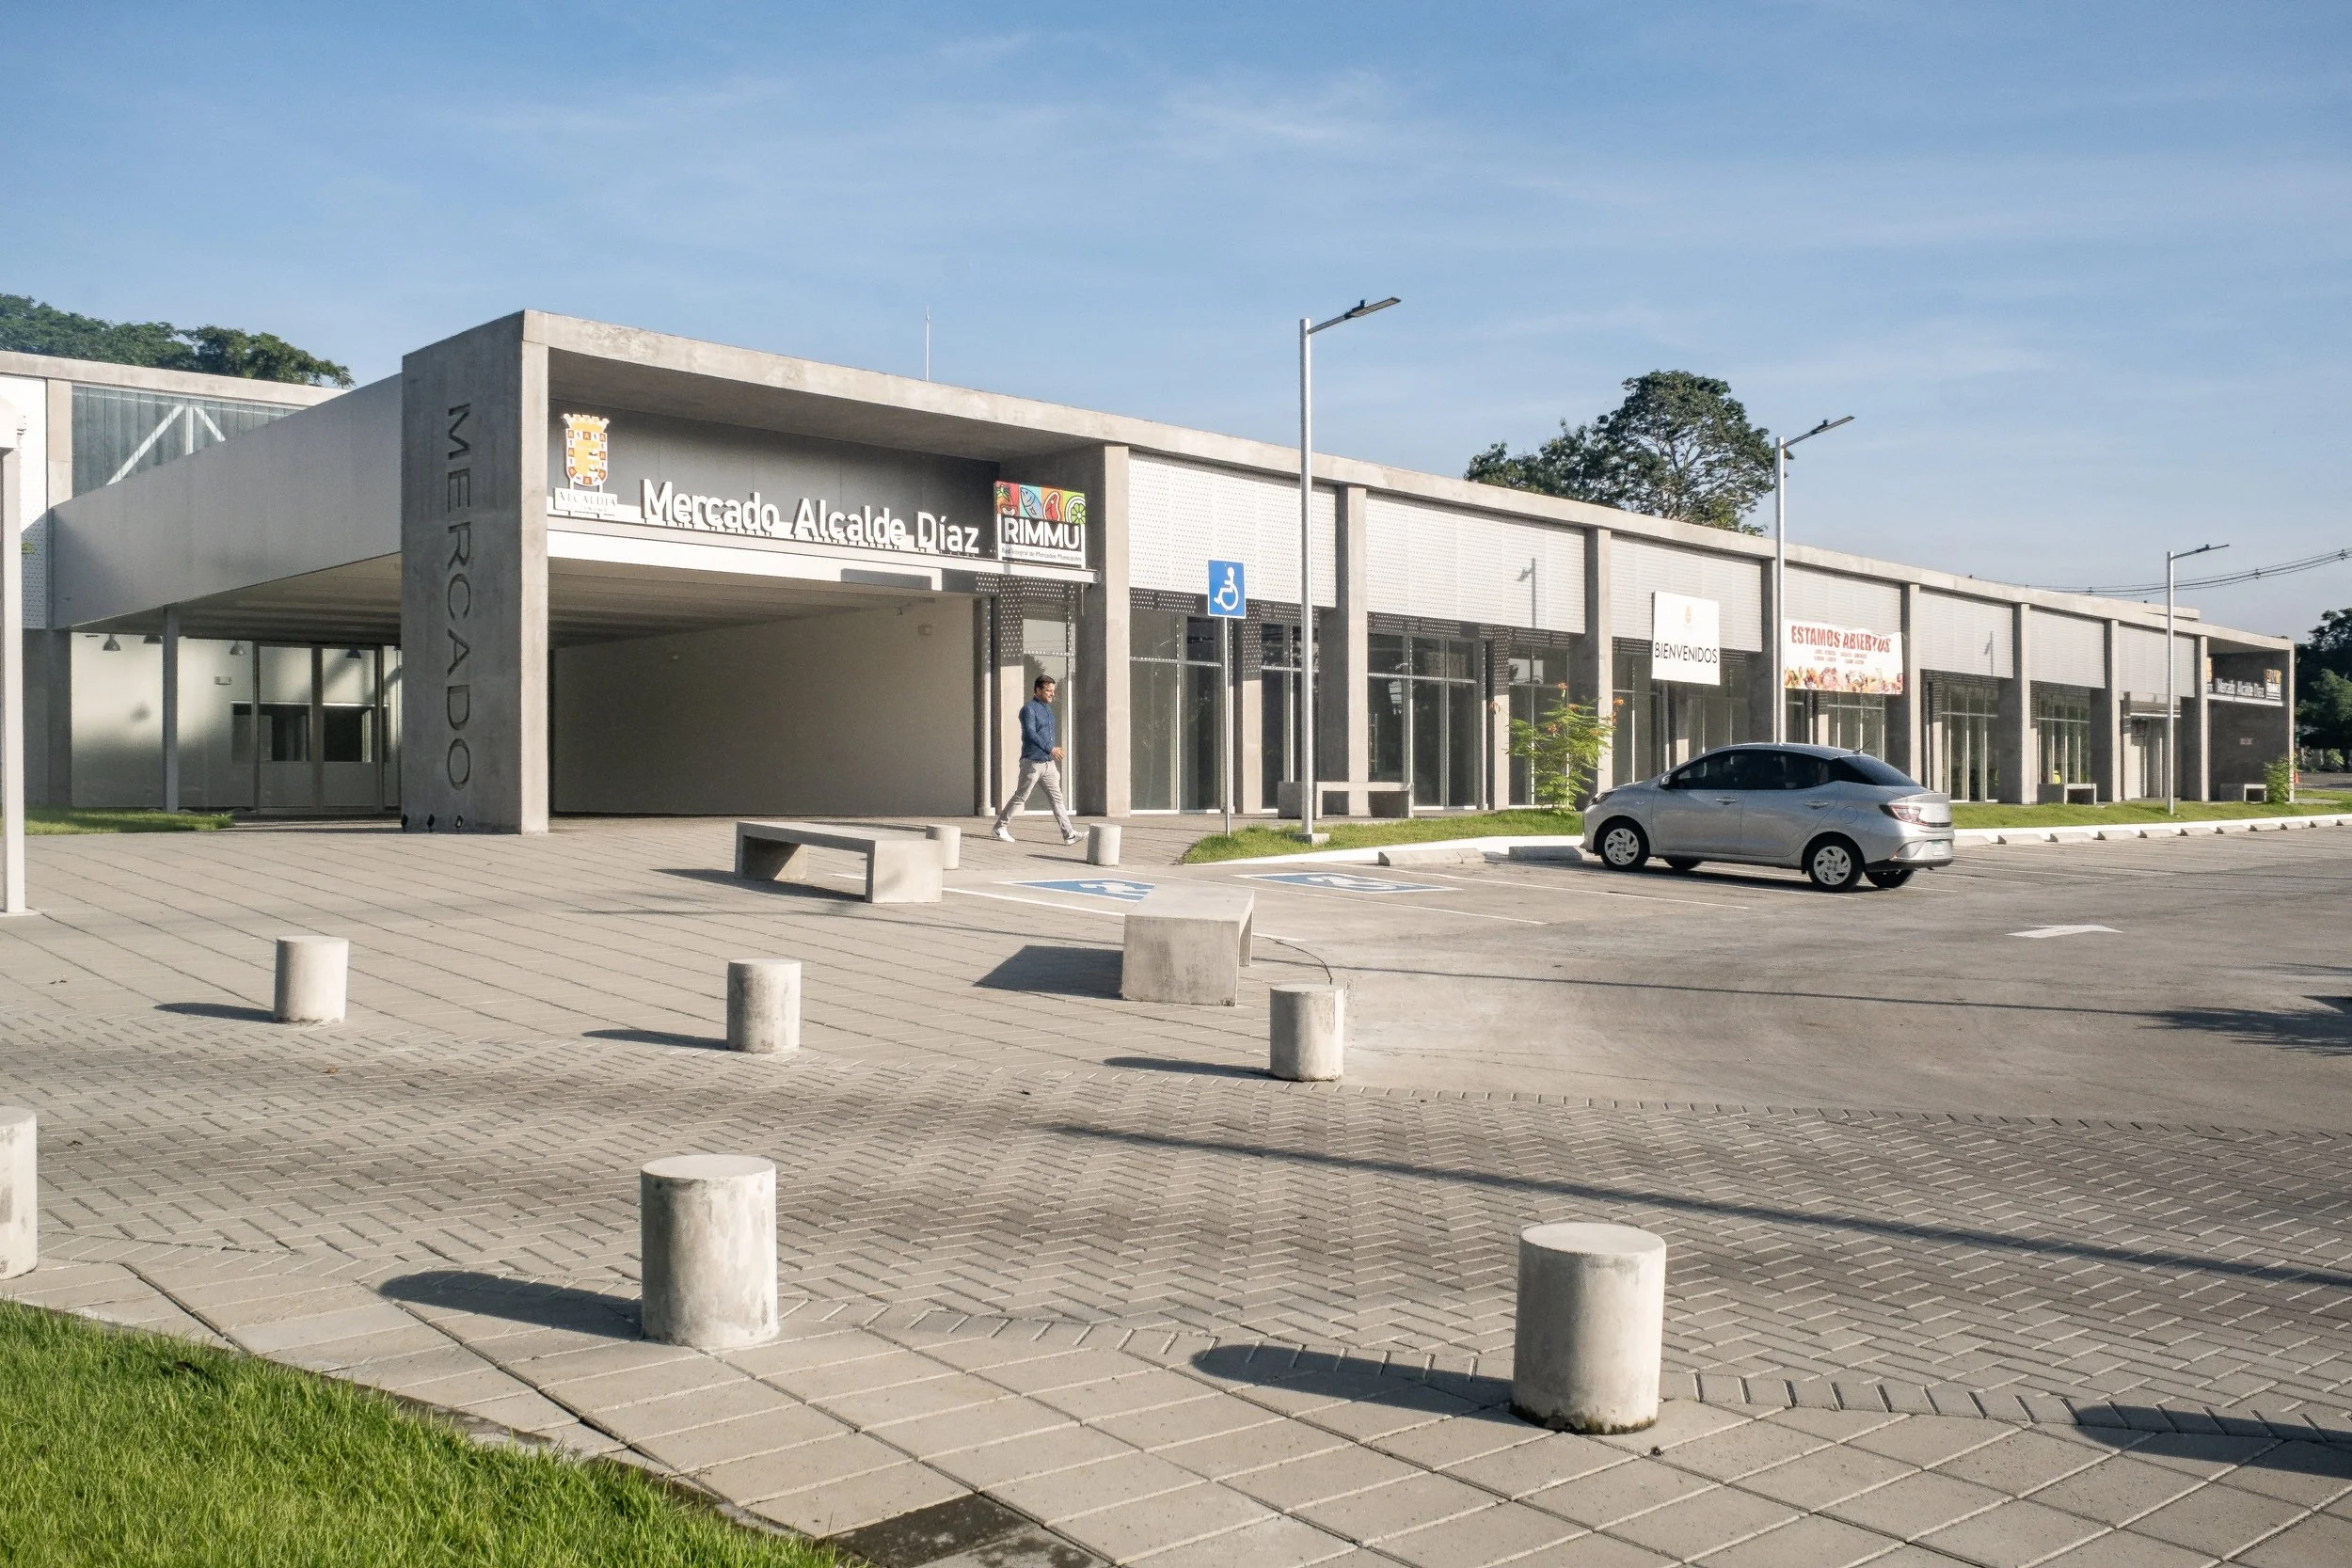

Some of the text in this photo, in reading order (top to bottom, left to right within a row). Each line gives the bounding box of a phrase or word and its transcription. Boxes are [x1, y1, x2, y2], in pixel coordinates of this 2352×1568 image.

[641, 478, 979, 554] Mercado Alcalde Díaz
[1004, 516, 1080, 550] RIMMU
[447, 403, 471, 791] MERCADO
[1654, 641, 1718, 664] BIENVENIDOS
[1790, 625, 1841, 649] ESTAMOS
